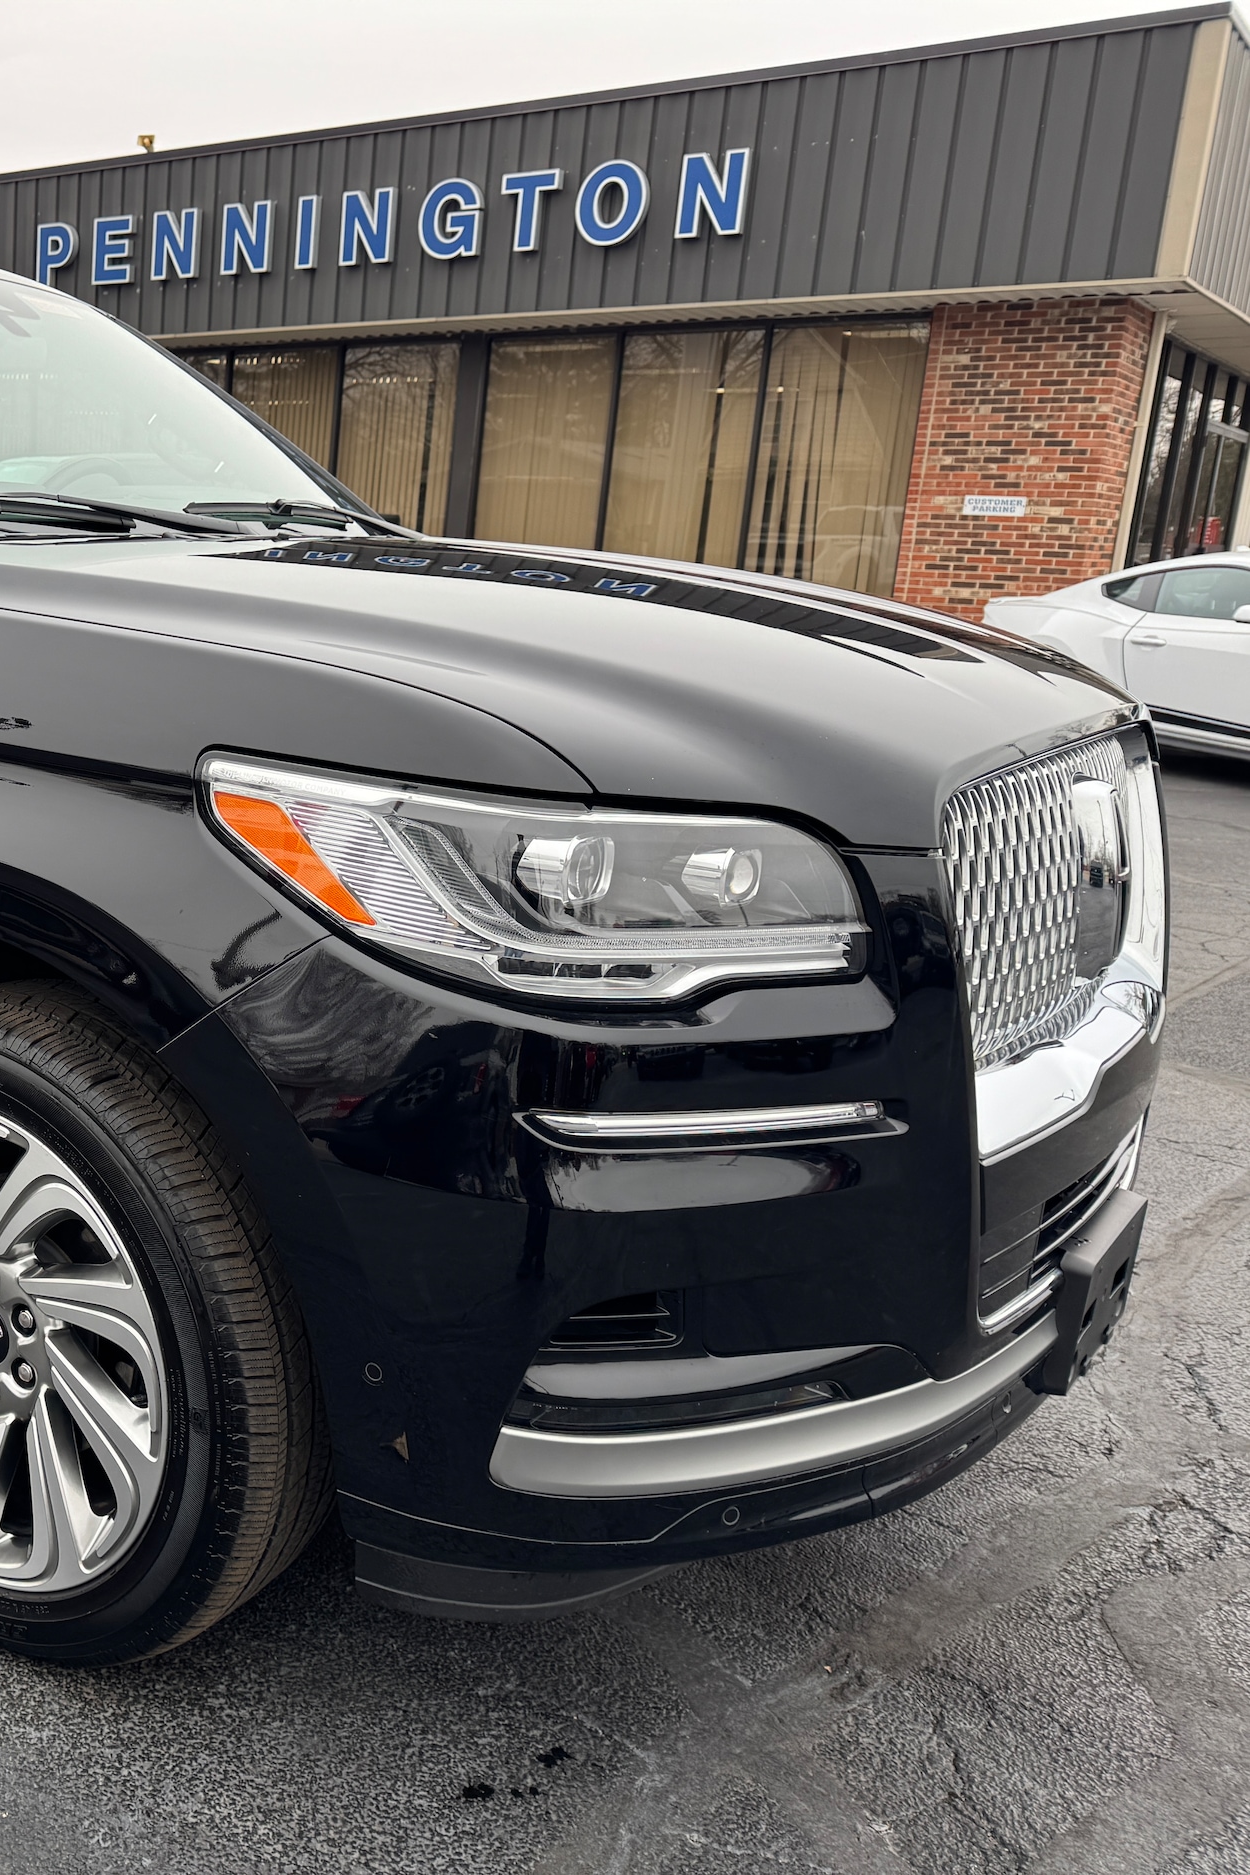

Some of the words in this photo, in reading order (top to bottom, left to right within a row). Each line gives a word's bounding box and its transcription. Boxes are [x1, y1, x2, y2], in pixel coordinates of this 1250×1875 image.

[36, 147, 750, 285] PENNINGTON
[967, 497, 1023, 507] CUSTOMER
[972, 505, 1016, 513] PARKING
